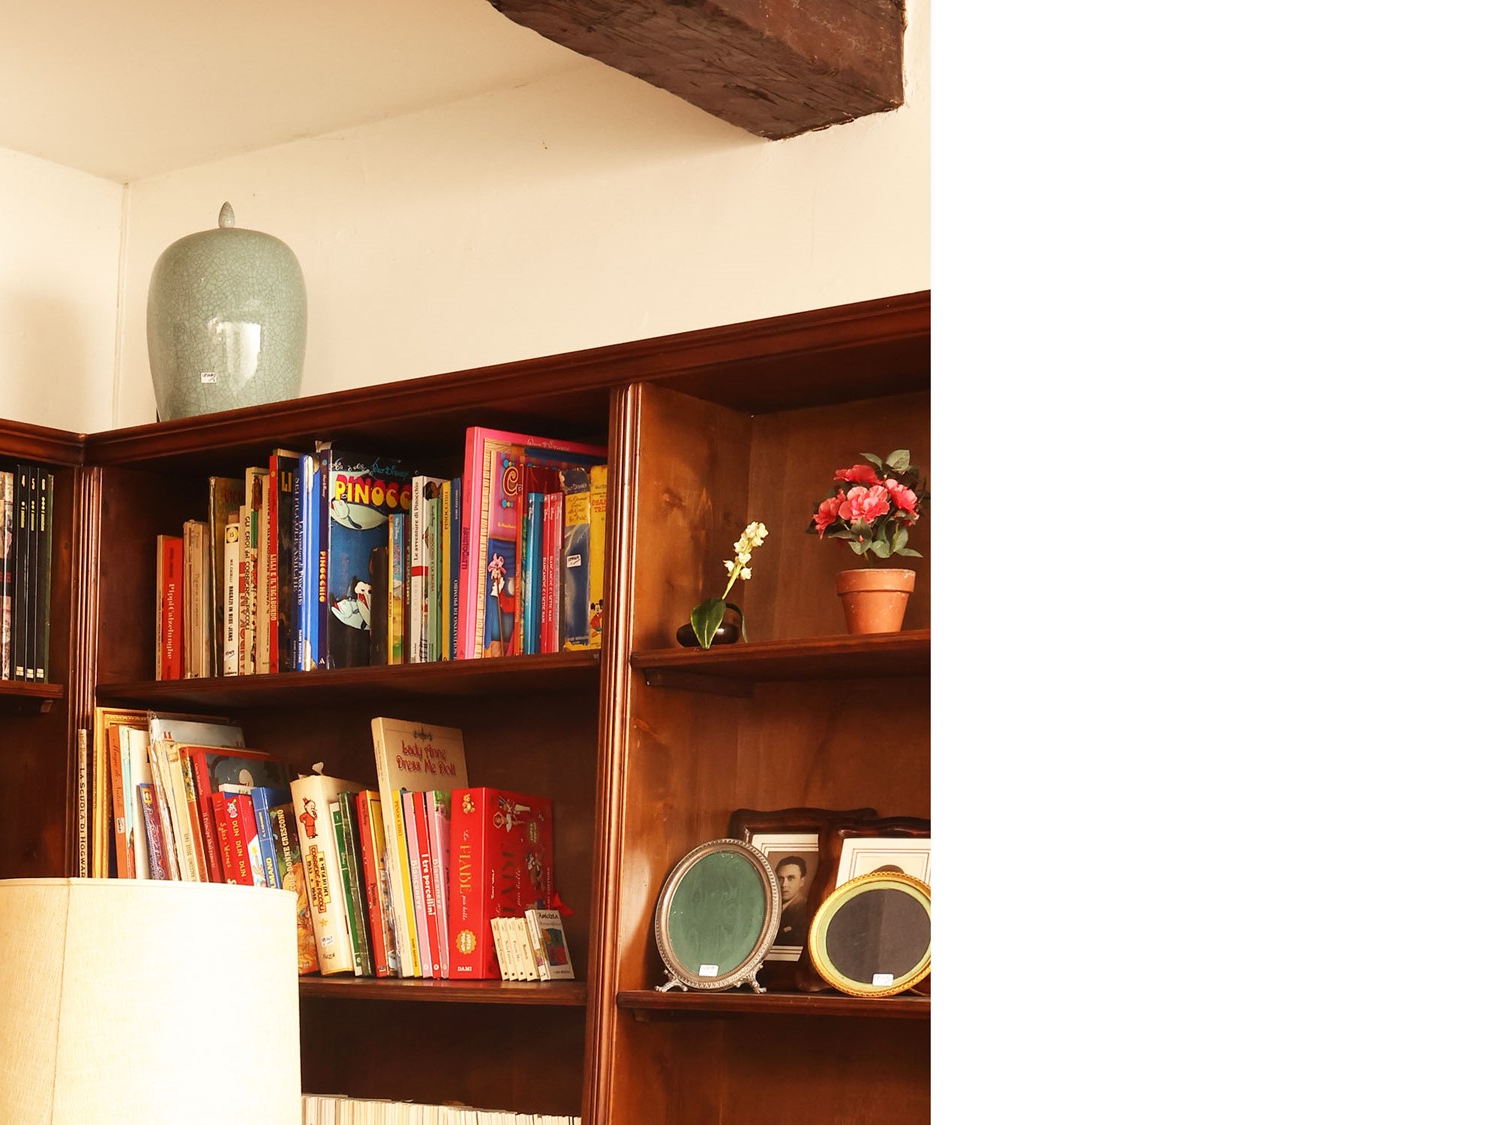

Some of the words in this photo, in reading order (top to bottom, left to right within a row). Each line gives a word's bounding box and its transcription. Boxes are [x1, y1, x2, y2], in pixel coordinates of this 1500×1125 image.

[21, 475, 26, 487] 4
[31, 478, 36, 490] 5
[412, 481, 420, 511] Pinocchio
[413, 552, 420, 561] Le
[462, 527, 471, 570] ARISTOGATTI
[243, 561, 251, 597] CORRIERE
[319, 550, 327, 603] PINOCCHIO
[167, 583, 175, 606] Pippi
[166, 606, 175, 660] Calzelunghe
[79, 767, 86, 781] LA
[424, 759, 437, 775] Me
[79, 823, 86, 833] DI
[274, 808, 292, 847] CRESCONO
[281, 845, 296, 872] DONNE
[421, 859, 430, 874] tre
[458, 845, 473, 894] FIABE
[310, 847, 321, 879] CORRIERE
[316, 887, 326, 911] PICCOLI
[422, 874, 435, 916] porcellini
